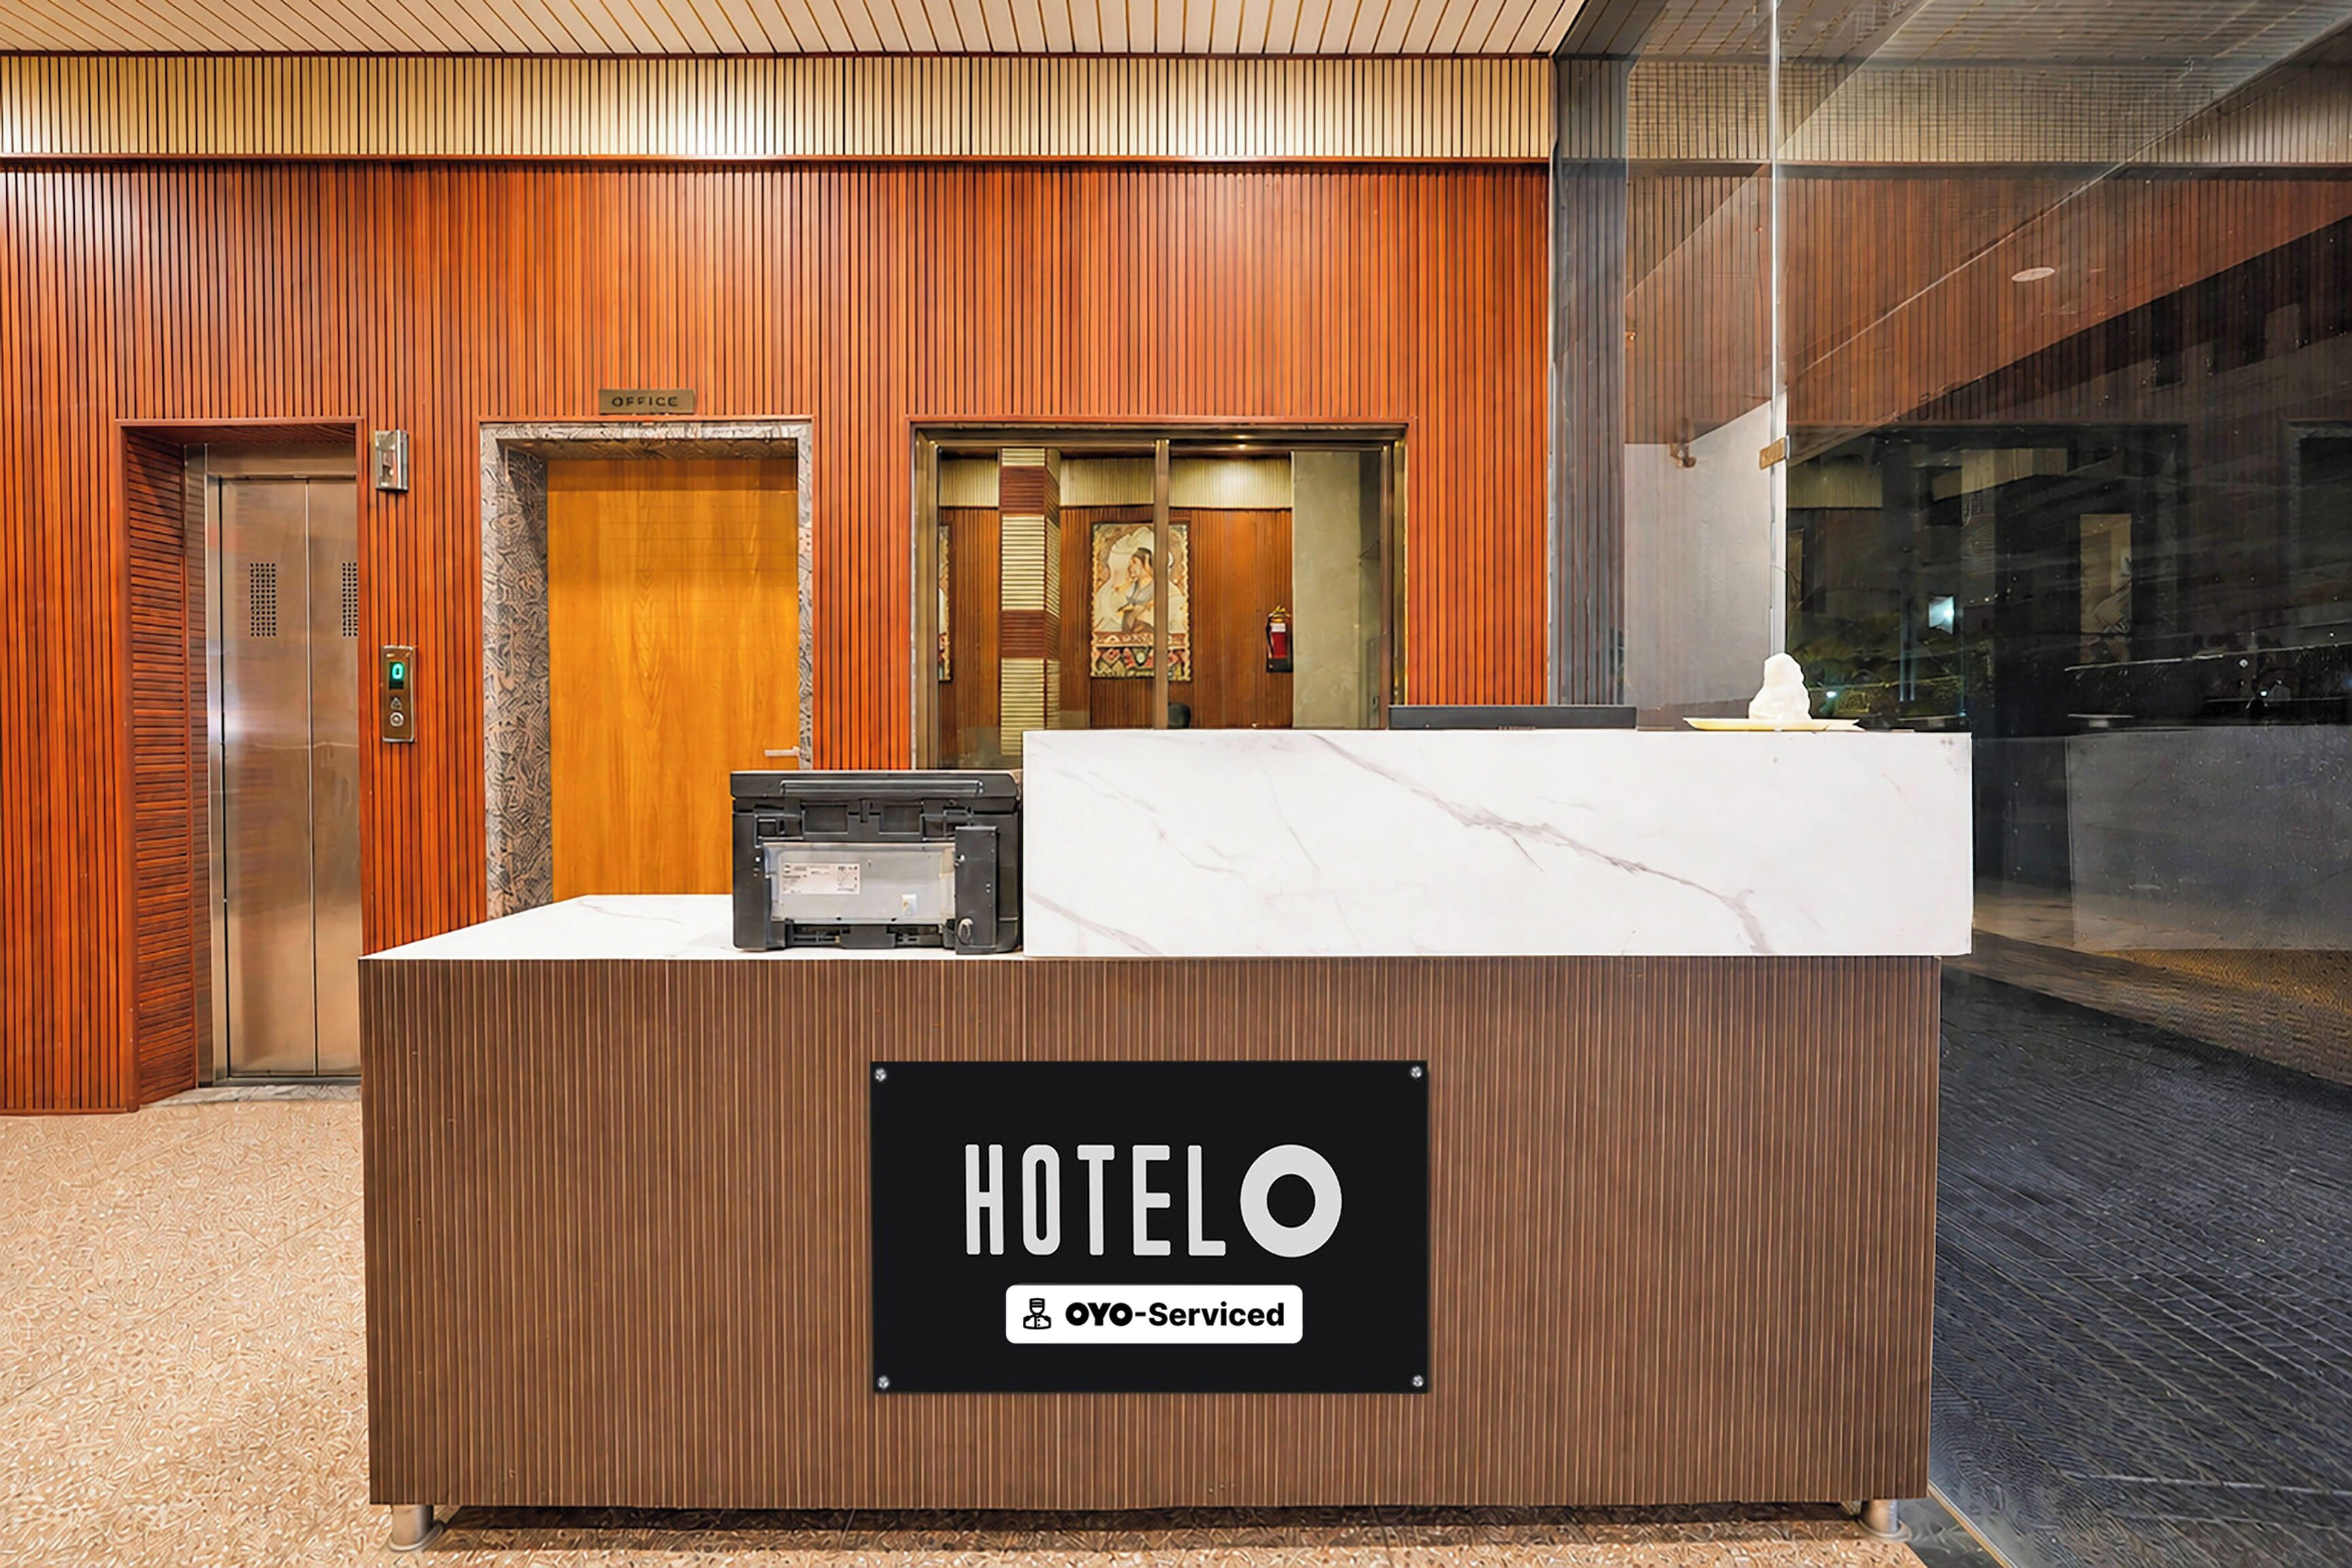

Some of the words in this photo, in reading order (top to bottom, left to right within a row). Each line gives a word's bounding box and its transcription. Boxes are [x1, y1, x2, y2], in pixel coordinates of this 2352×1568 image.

[611, 397, 679, 407] OFFICE
[392, 664, 404, 679] 0
[965, 1144, 1226, 1256] HOTEL
[1240, 1144, 1342, 1258] O
[1065, 1301, 1285, 1327] OYO-Serviced
